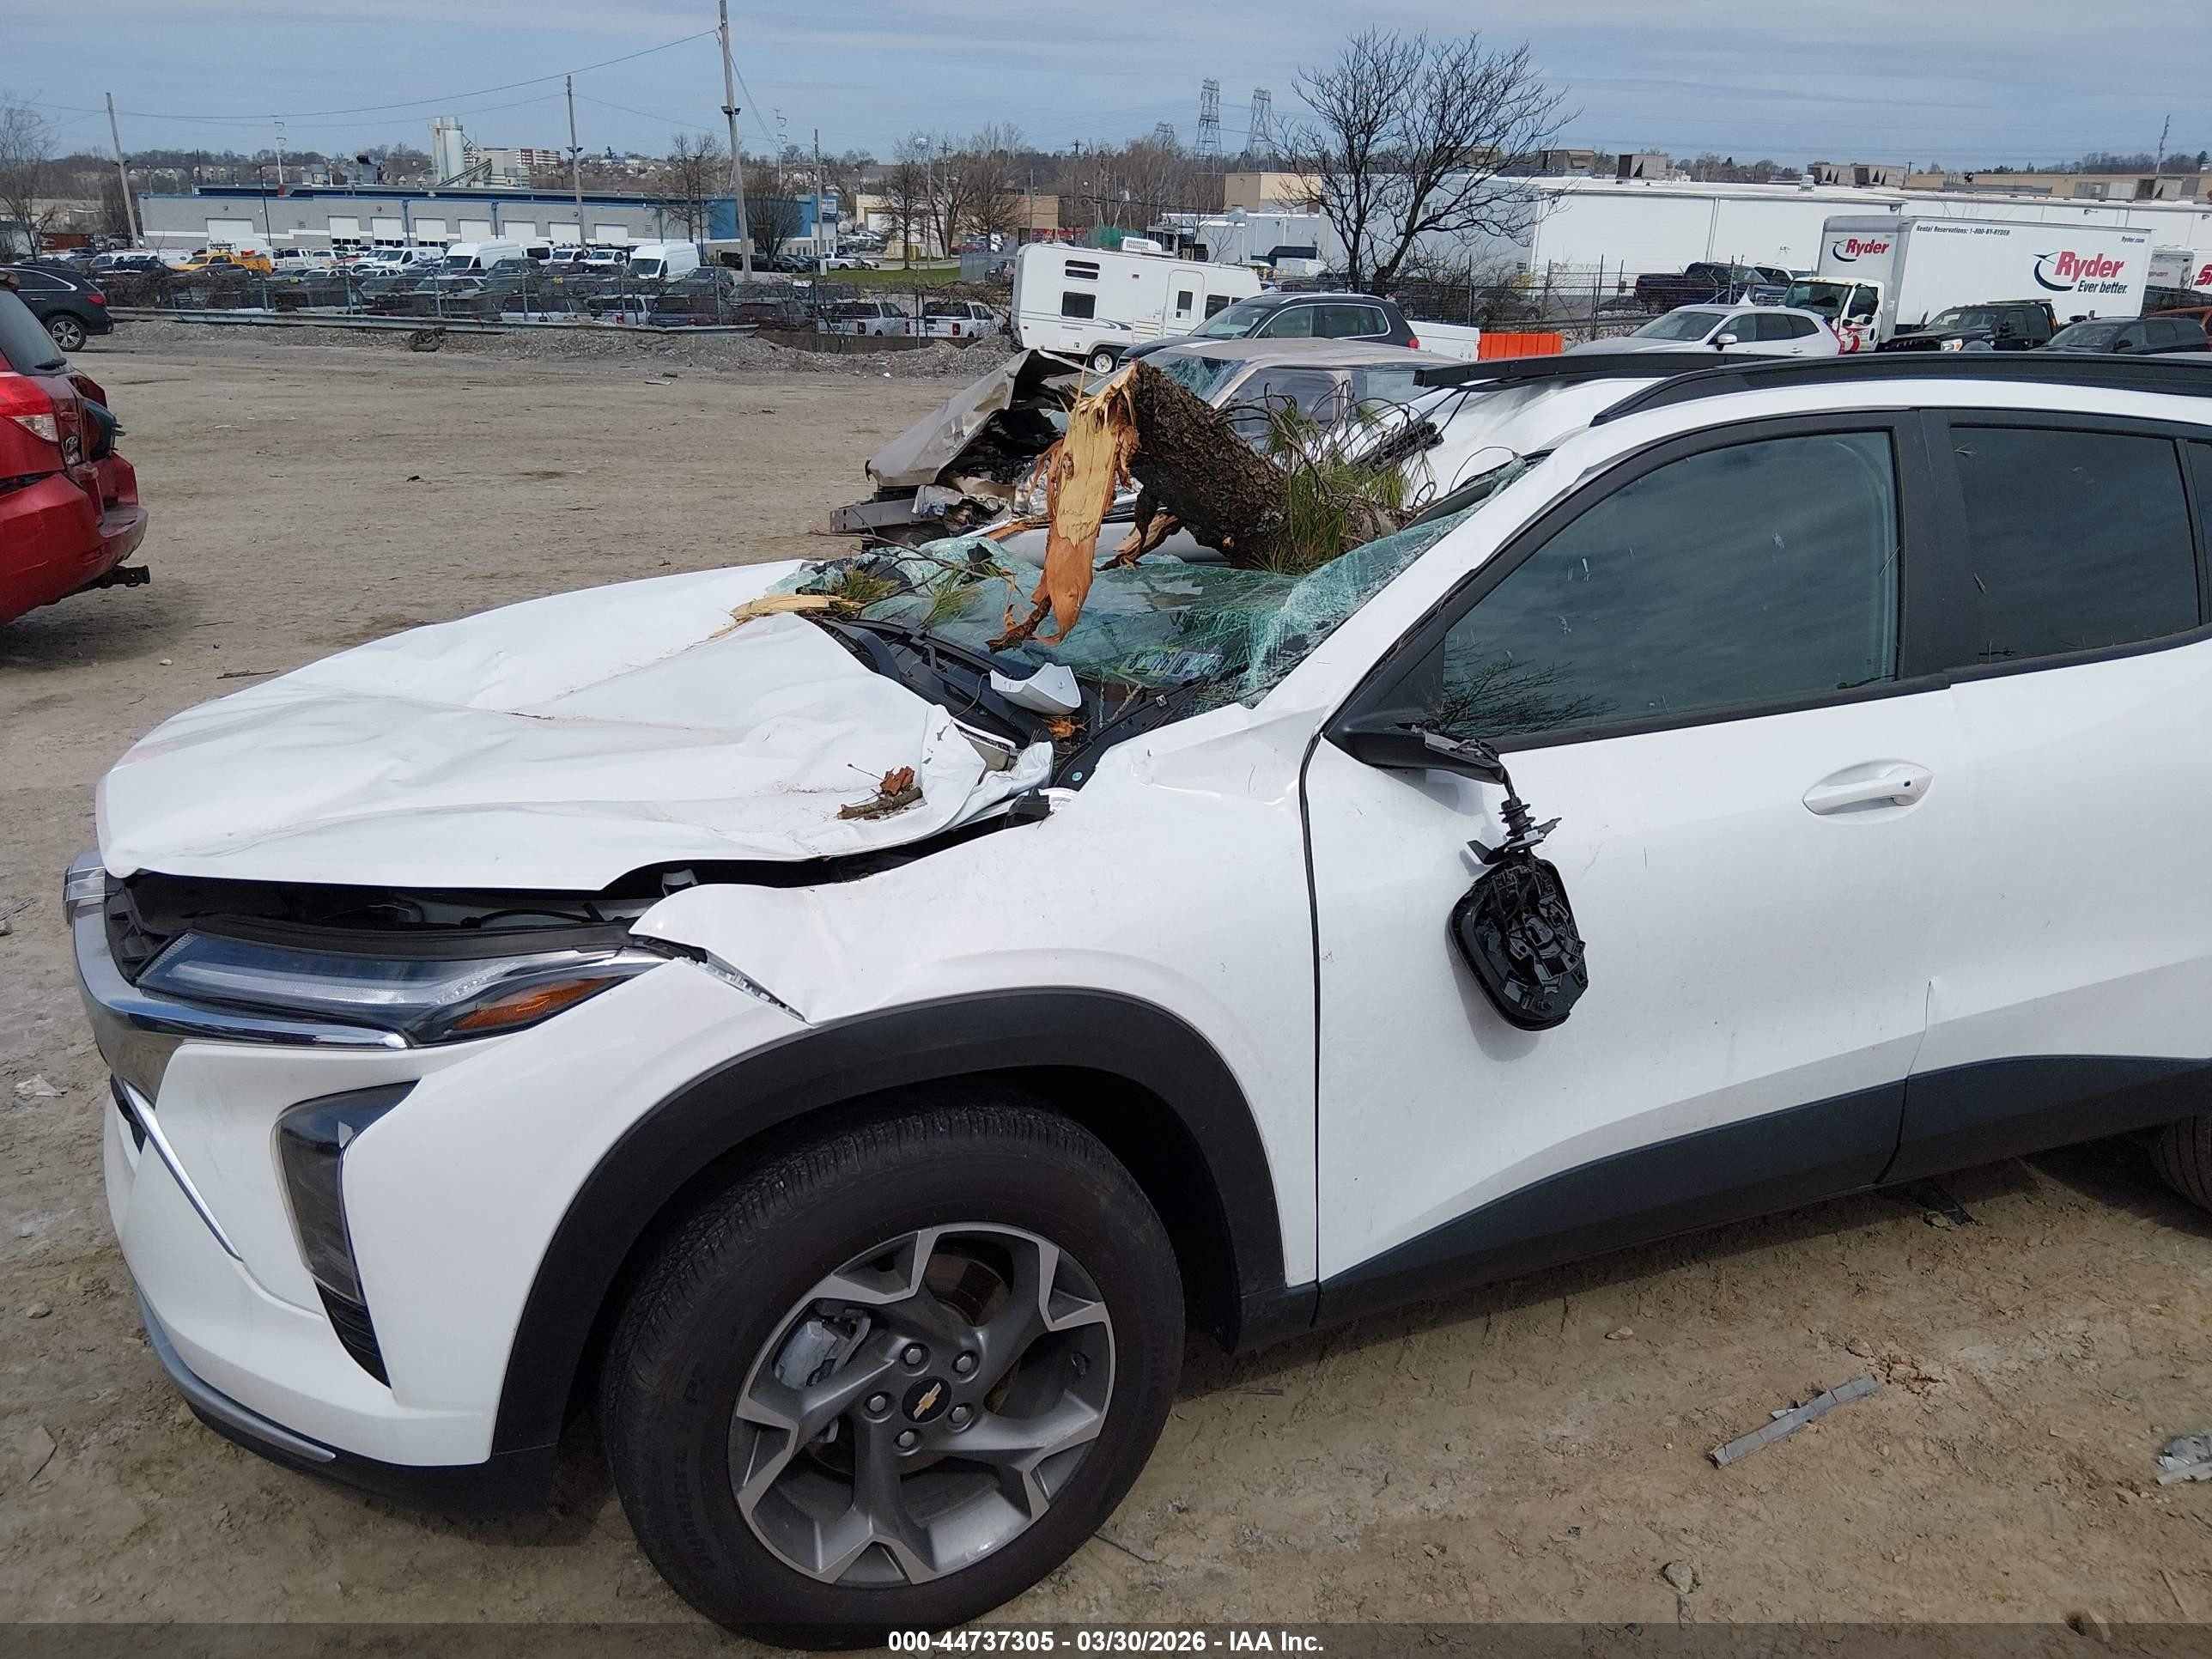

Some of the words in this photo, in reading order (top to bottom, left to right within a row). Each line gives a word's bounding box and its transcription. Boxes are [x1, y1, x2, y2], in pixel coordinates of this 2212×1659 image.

[1845, 239, 1890, 257] Ryder
[2054, 251, 2125, 283] Ryder
[2076, 280, 2100, 293] Ever
[2099, 281, 2128, 294] better.
